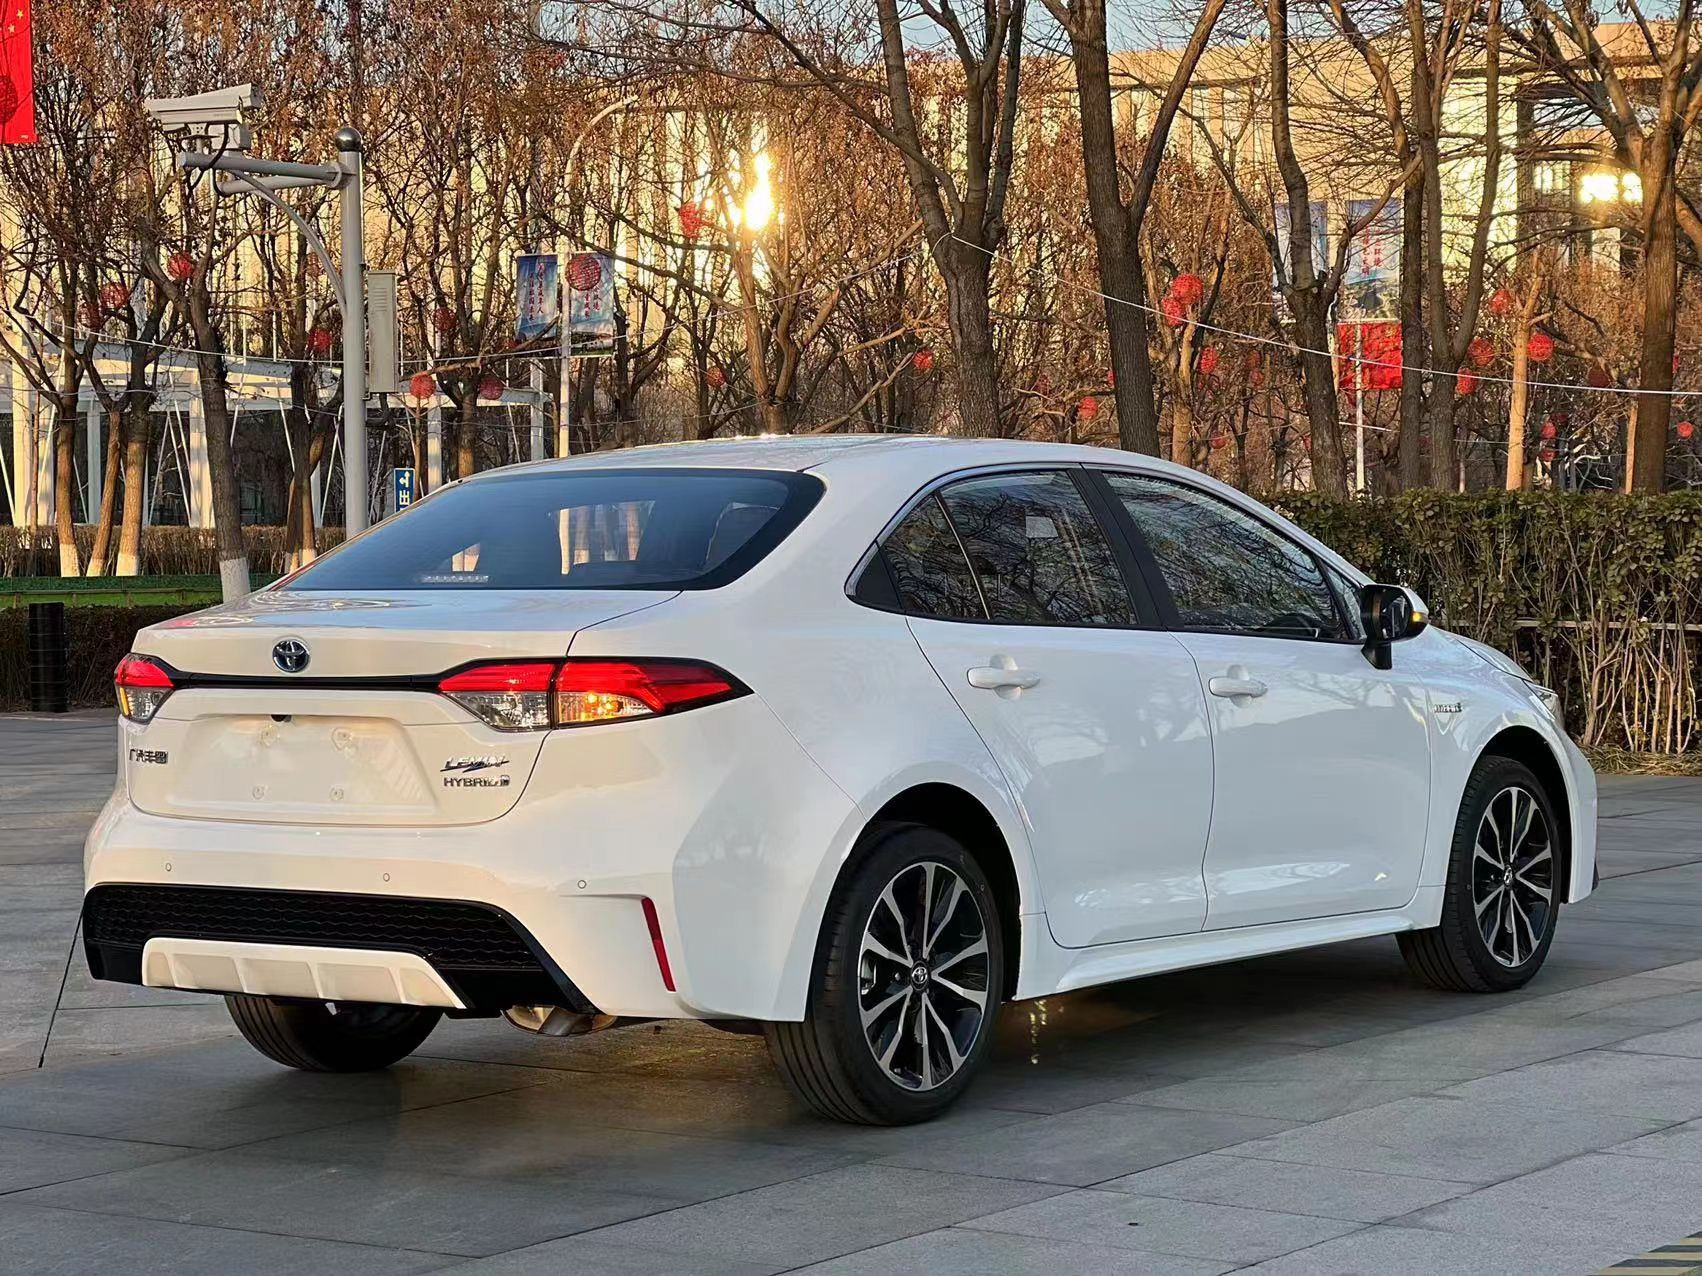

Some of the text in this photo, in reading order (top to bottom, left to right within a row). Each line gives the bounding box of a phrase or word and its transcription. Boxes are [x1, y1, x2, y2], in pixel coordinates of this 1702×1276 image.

[129, 748, 168, 764] 广汽丰田
[443, 776, 500, 787] HYBRID
